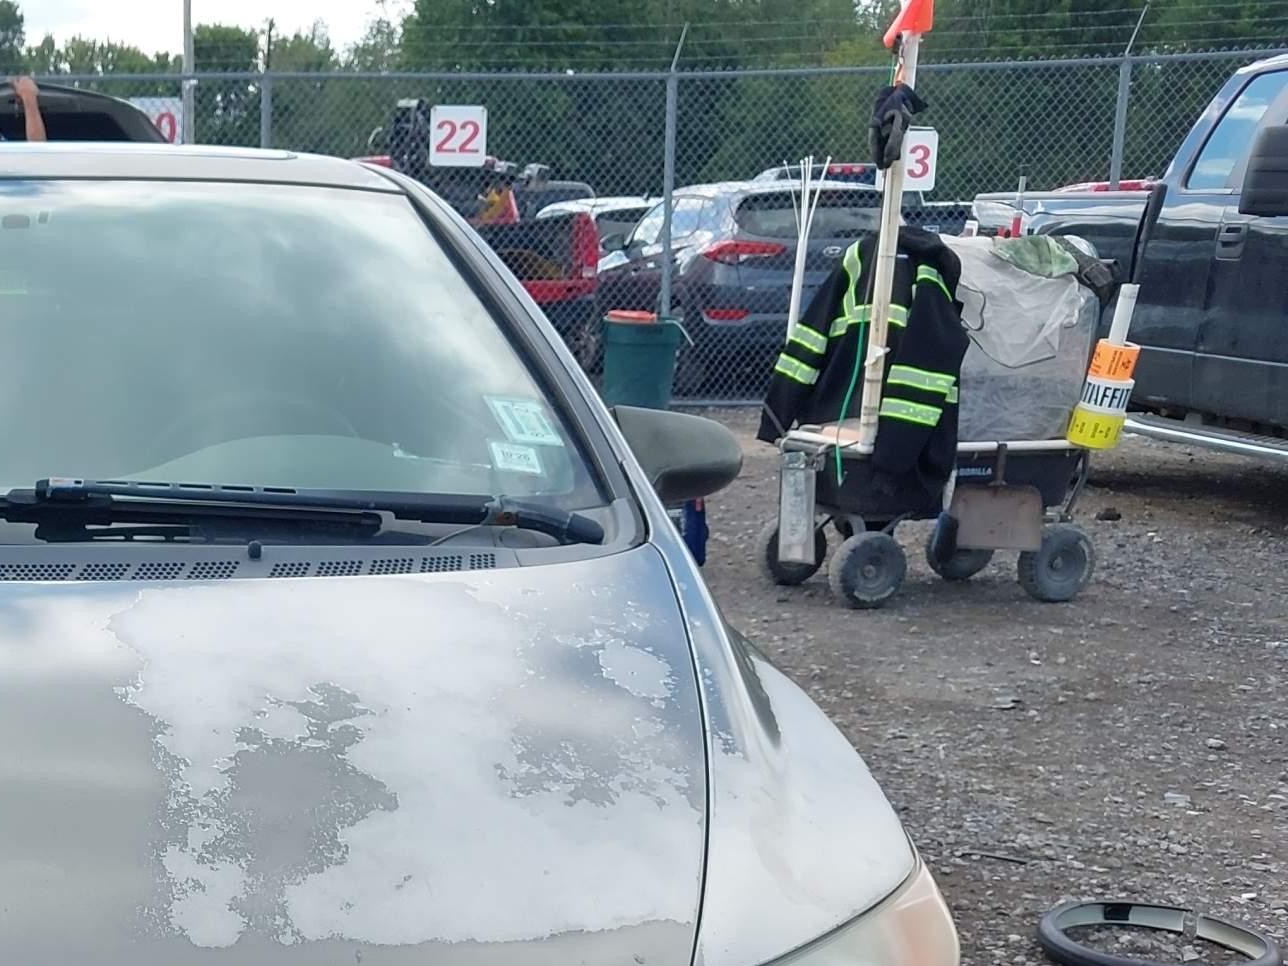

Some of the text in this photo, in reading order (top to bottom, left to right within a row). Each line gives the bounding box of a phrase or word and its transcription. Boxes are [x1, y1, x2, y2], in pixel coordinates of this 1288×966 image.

[153, 112, 176, 143] 0
[435, 120, 480, 153] 22
[907, 144, 931, 178] 3
